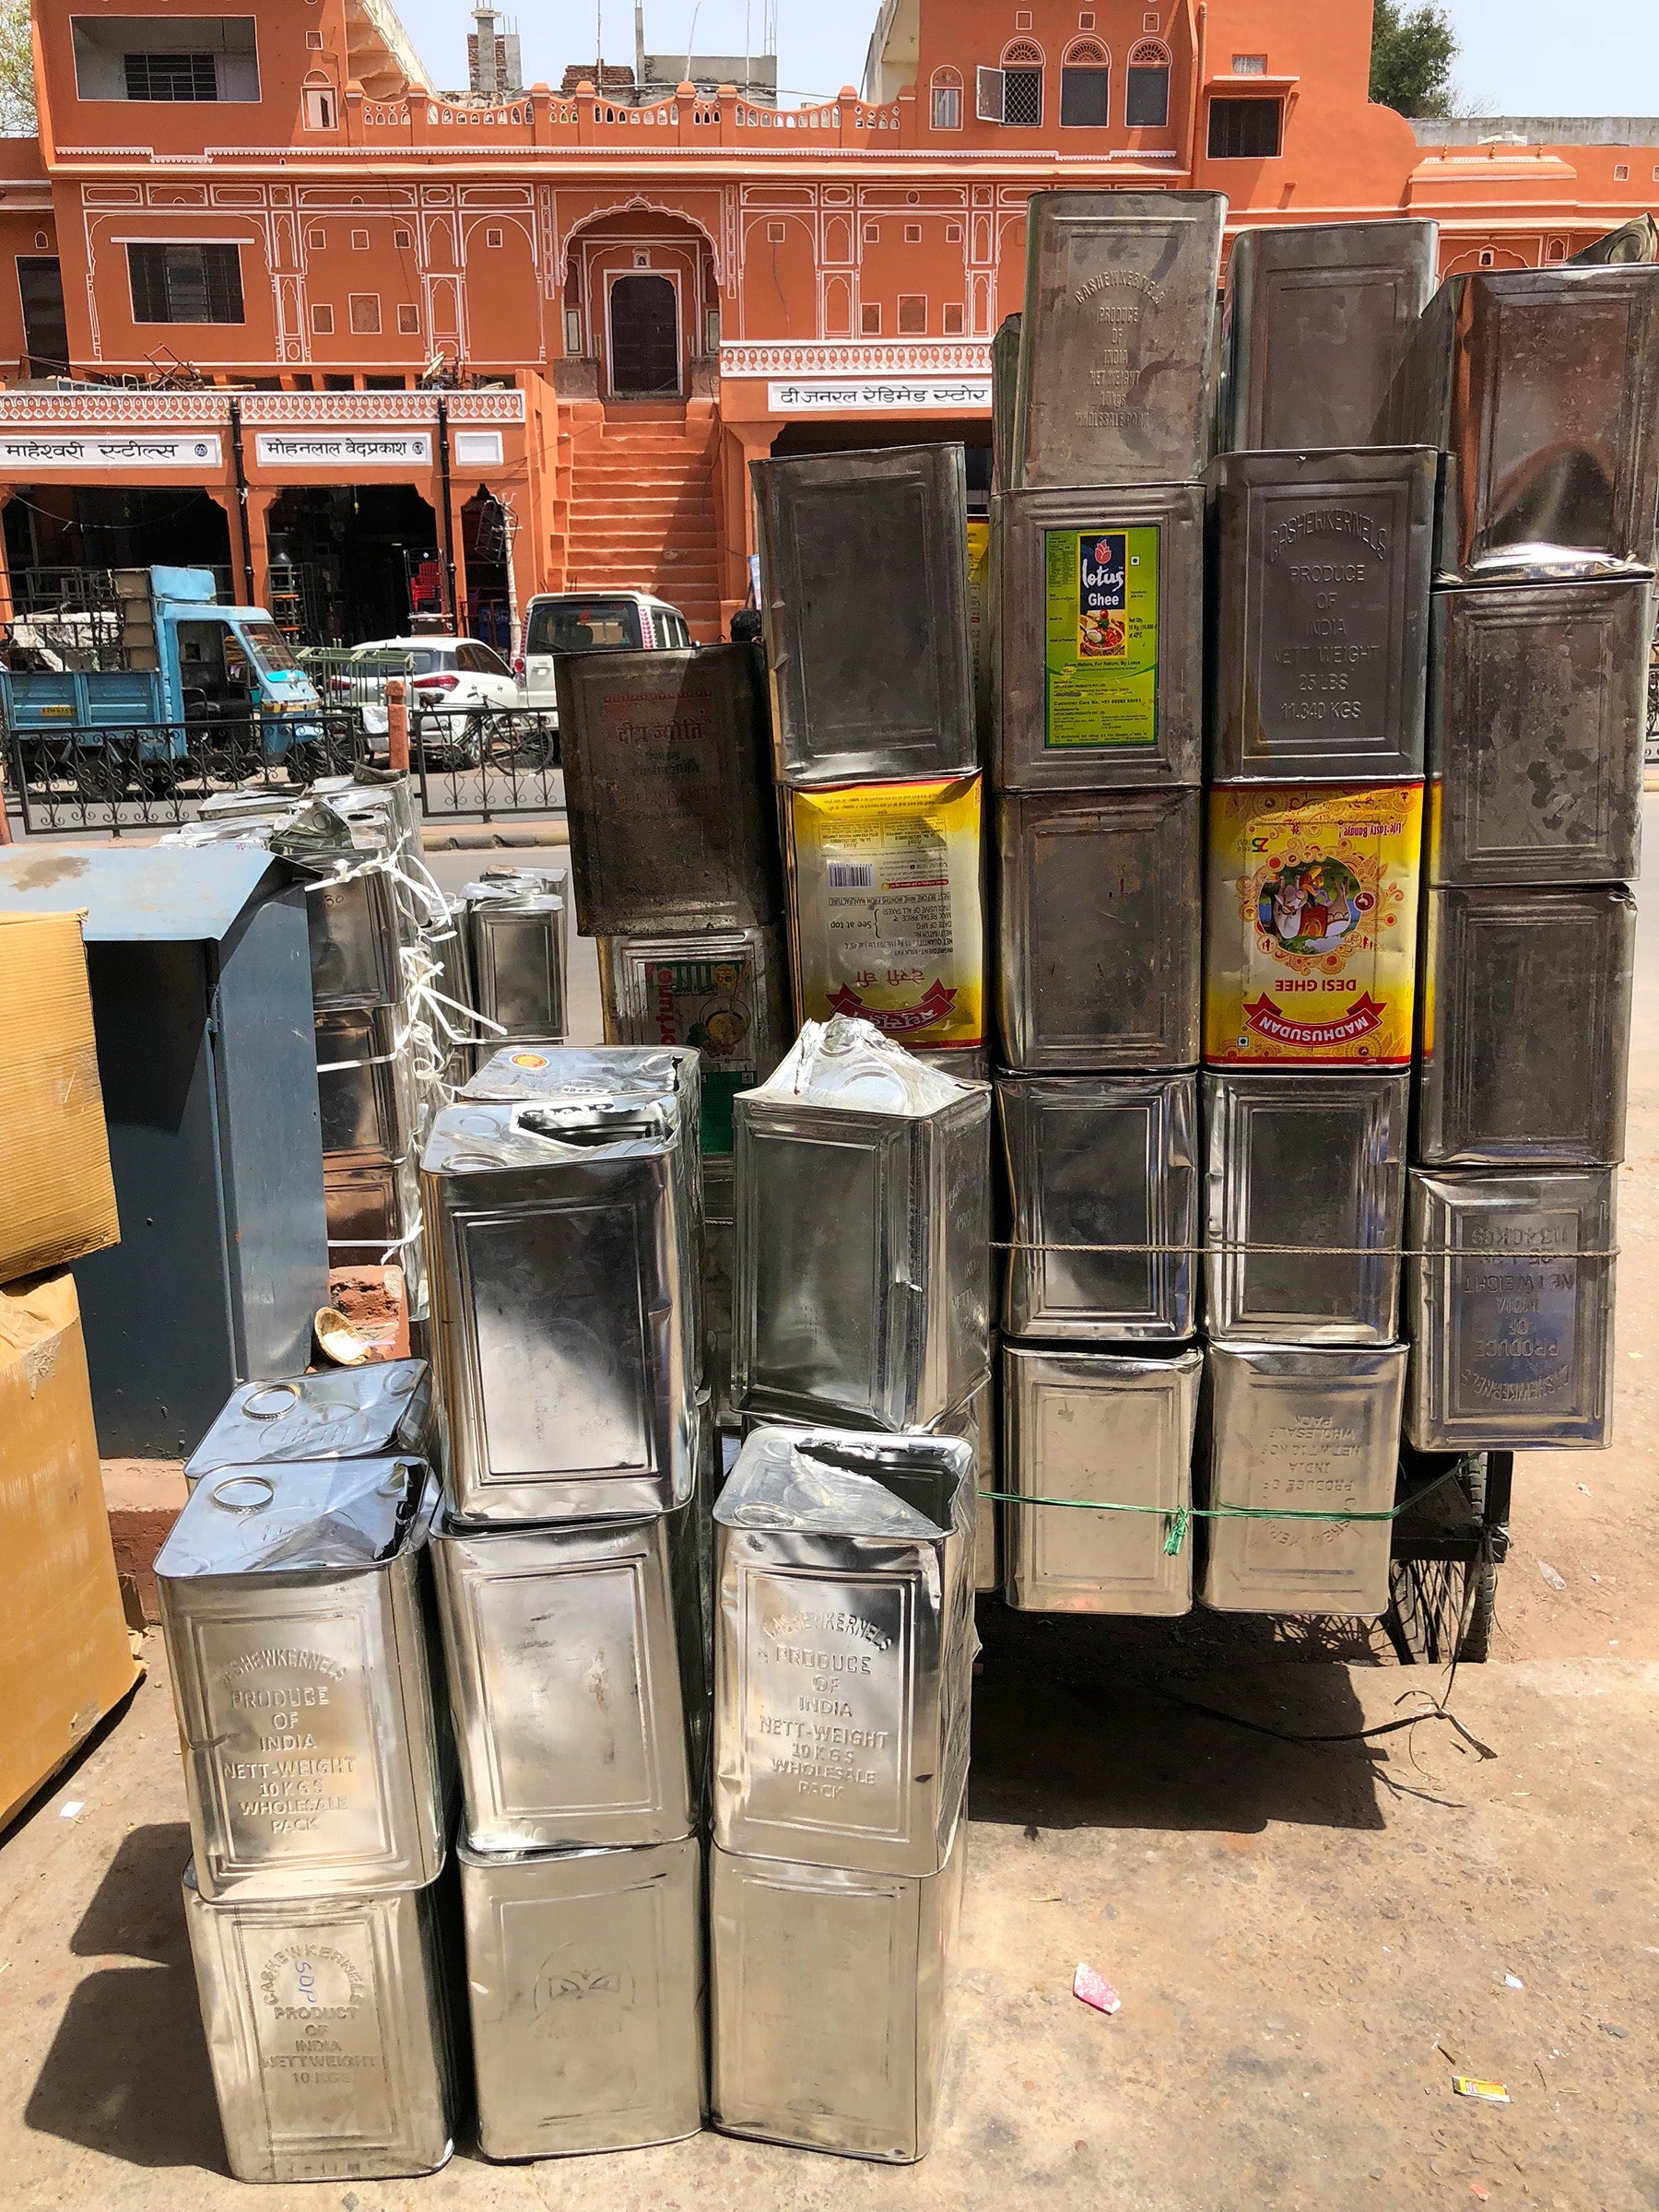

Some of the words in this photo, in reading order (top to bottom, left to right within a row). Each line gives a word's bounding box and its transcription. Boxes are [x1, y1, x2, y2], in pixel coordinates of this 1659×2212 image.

[1100, 307, 1138, 323] PRODUCE
[1112, 329, 1123, 345] OF
[1103, 349, 1128, 365] INDIA
[934, 385, 989, 403] स्टोर
[6, 441, 85, 460] माहेश्वरी
[98, 441, 179, 460] स्टील्स
[266, 439, 343, 457] मोहनलाल
[346, 438, 407, 457] वेदप्रकाश
[1290, 564, 1365, 582] PRODUCE
[1088, 593, 1119, 606] Ghee
[1316, 593, 1337, 609] OF
[1306, 618, 1347, 636] INDIA
[1318, 646, 1380, 663] WEIGHT
[1331, 701, 1362, 718] KGS
[1344, 826, 1368, 838] Banaye
[1252, 837, 1268, 853] 25
[830, 921, 843, 929] top
[856, 970, 877, 988] घी
[887, 969, 925, 987] देसी
[1275, 980, 1318, 992] GHEE
[1322, 980, 1357, 992] DESI
[655, 969, 677, 1044] ortune
[1258, 1016, 1369, 1042] MADHUSUDAN
[1508, 1318, 1529, 1335] OF
[1475, 1340, 1558, 1357] PRODUCE
[1294, 1415, 1332, 1426] PACK
[1288, 1463, 1330, 1474] INDIA
[1286, 1479, 1353, 1492] PRODUCE
[776, 1645, 872, 1675] PRODUCE
[813, 1675, 841, 1693] OF
[232, 1687, 329, 1709] PRODUCE
[799, 1697, 853, 1717] INDIA
[272, 1711, 299, 1731] OF
[260, 1734, 317, 1751] INDIA
[792, 1741, 810, 1759] 10
[771, 1757, 876, 1784] WHOLESALE
[260, 1783, 276, 1797] 10
[798, 1781, 844, 1799] PACK
[239, 1797, 348, 1816] WHOLESALE
[271, 1818, 320, 1834] PACK
[274, 2006, 359, 2020] PRODUCT
[305, 2024, 330, 2036] OF
[295, 2041, 342, 2053] INDIA
[292, 2073, 310, 2084] 10
